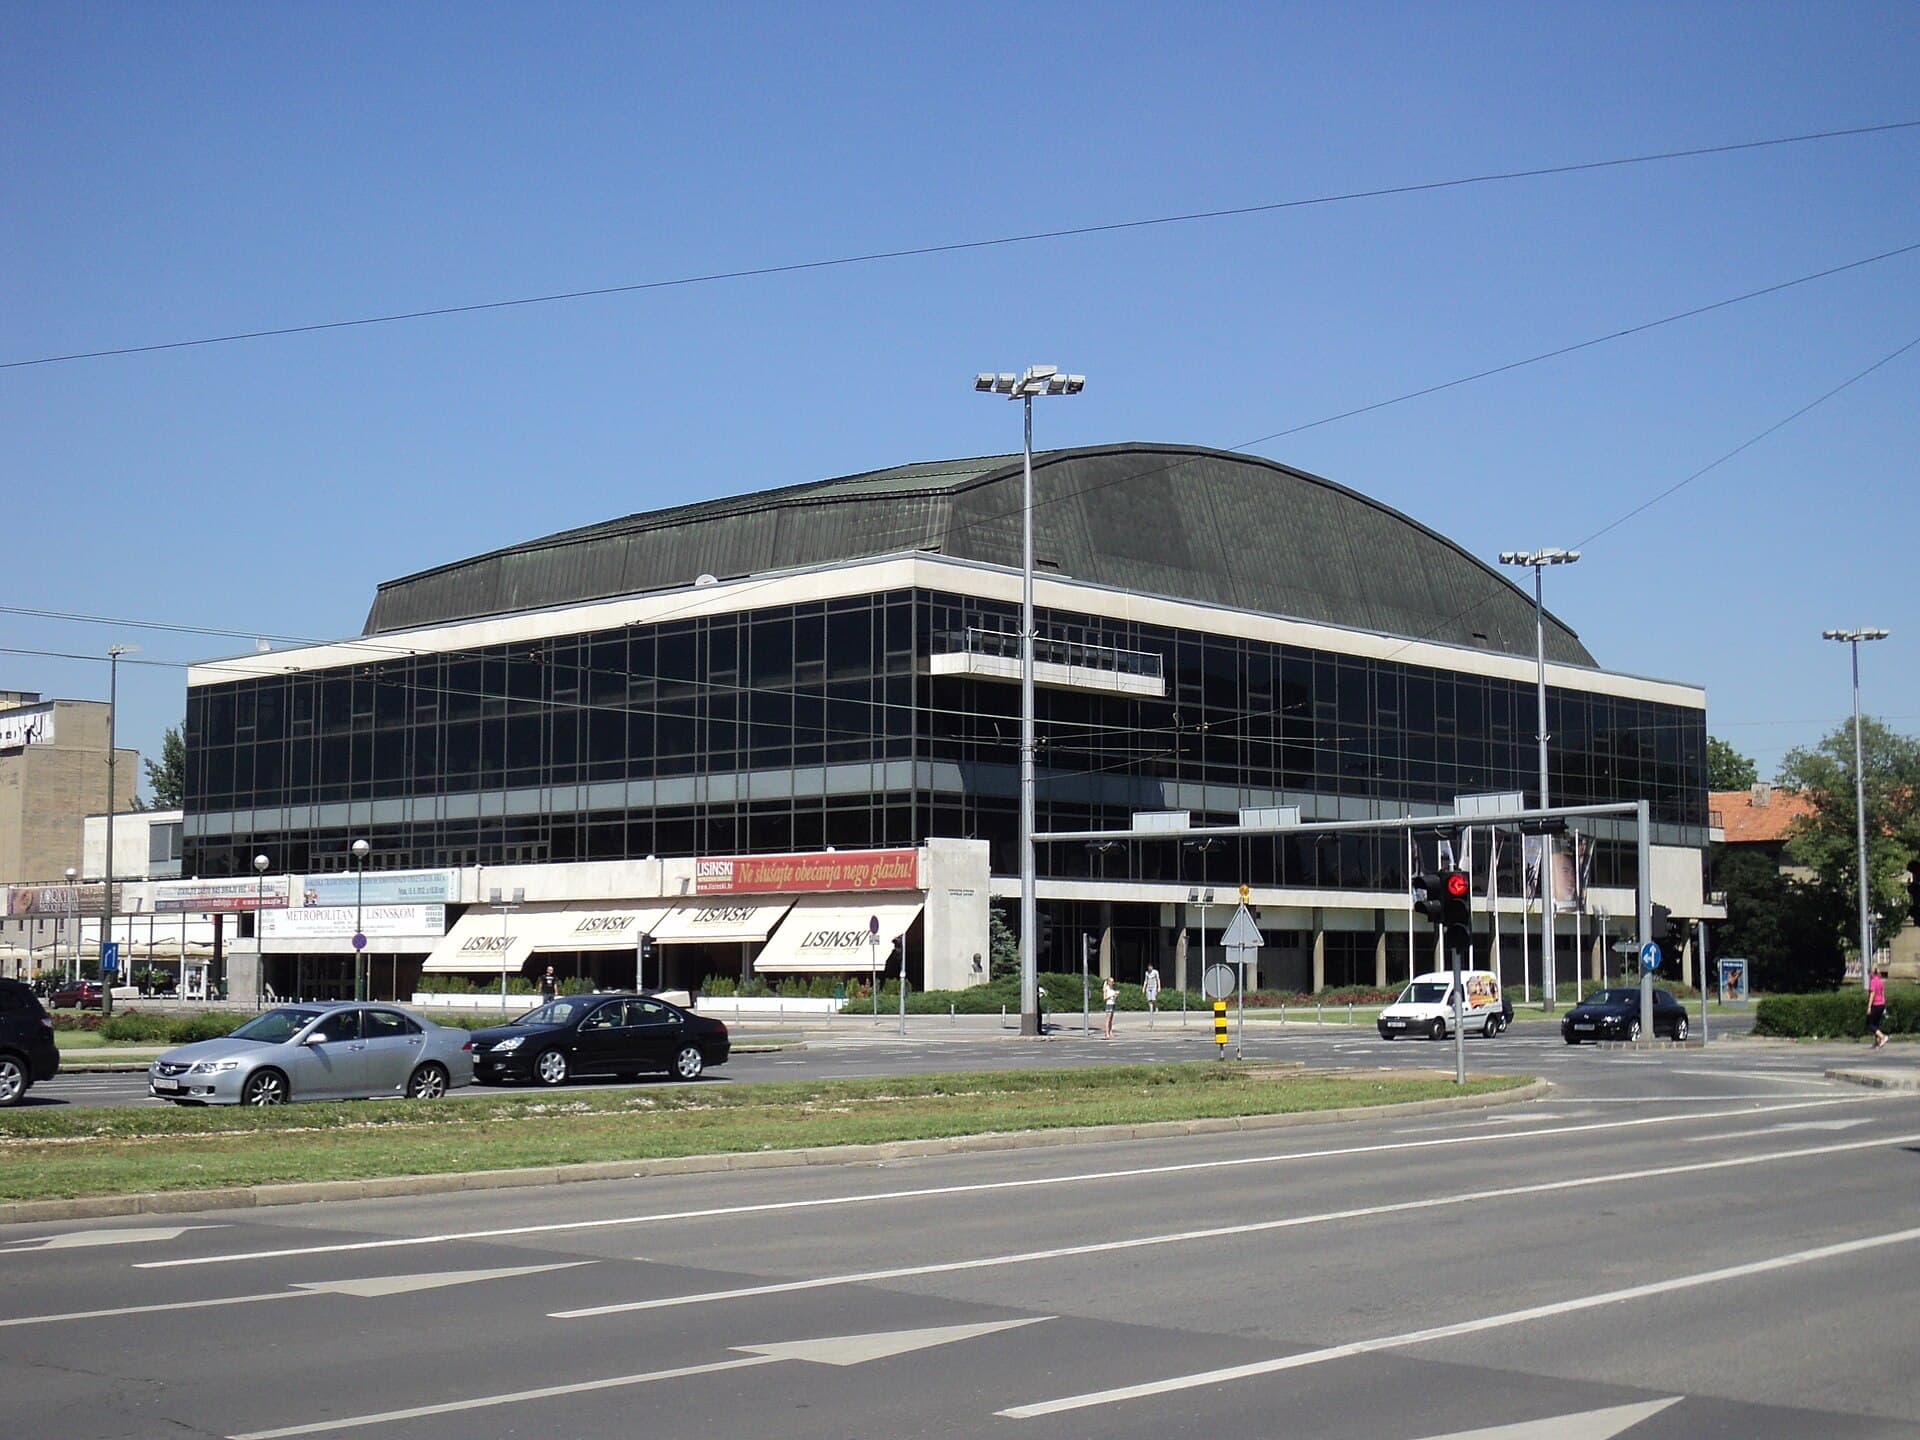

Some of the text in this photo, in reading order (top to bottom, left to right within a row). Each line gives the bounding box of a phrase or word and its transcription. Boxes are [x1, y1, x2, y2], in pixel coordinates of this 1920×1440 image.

[738, 862, 753, 883] Ne
[843, 864, 869, 887] nego
[870, 856, 914, 887] glazbu!
[286, 909, 353, 921] METROPOLITAN
[366, 908, 415, 920] LISINSKOM
[692, 906, 758, 922] LISINSKI
[575, 916, 635, 931] LISINSKI
[462, 936, 517, 950] LISINSKI
[801, 930, 871, 948] LISINSKI
